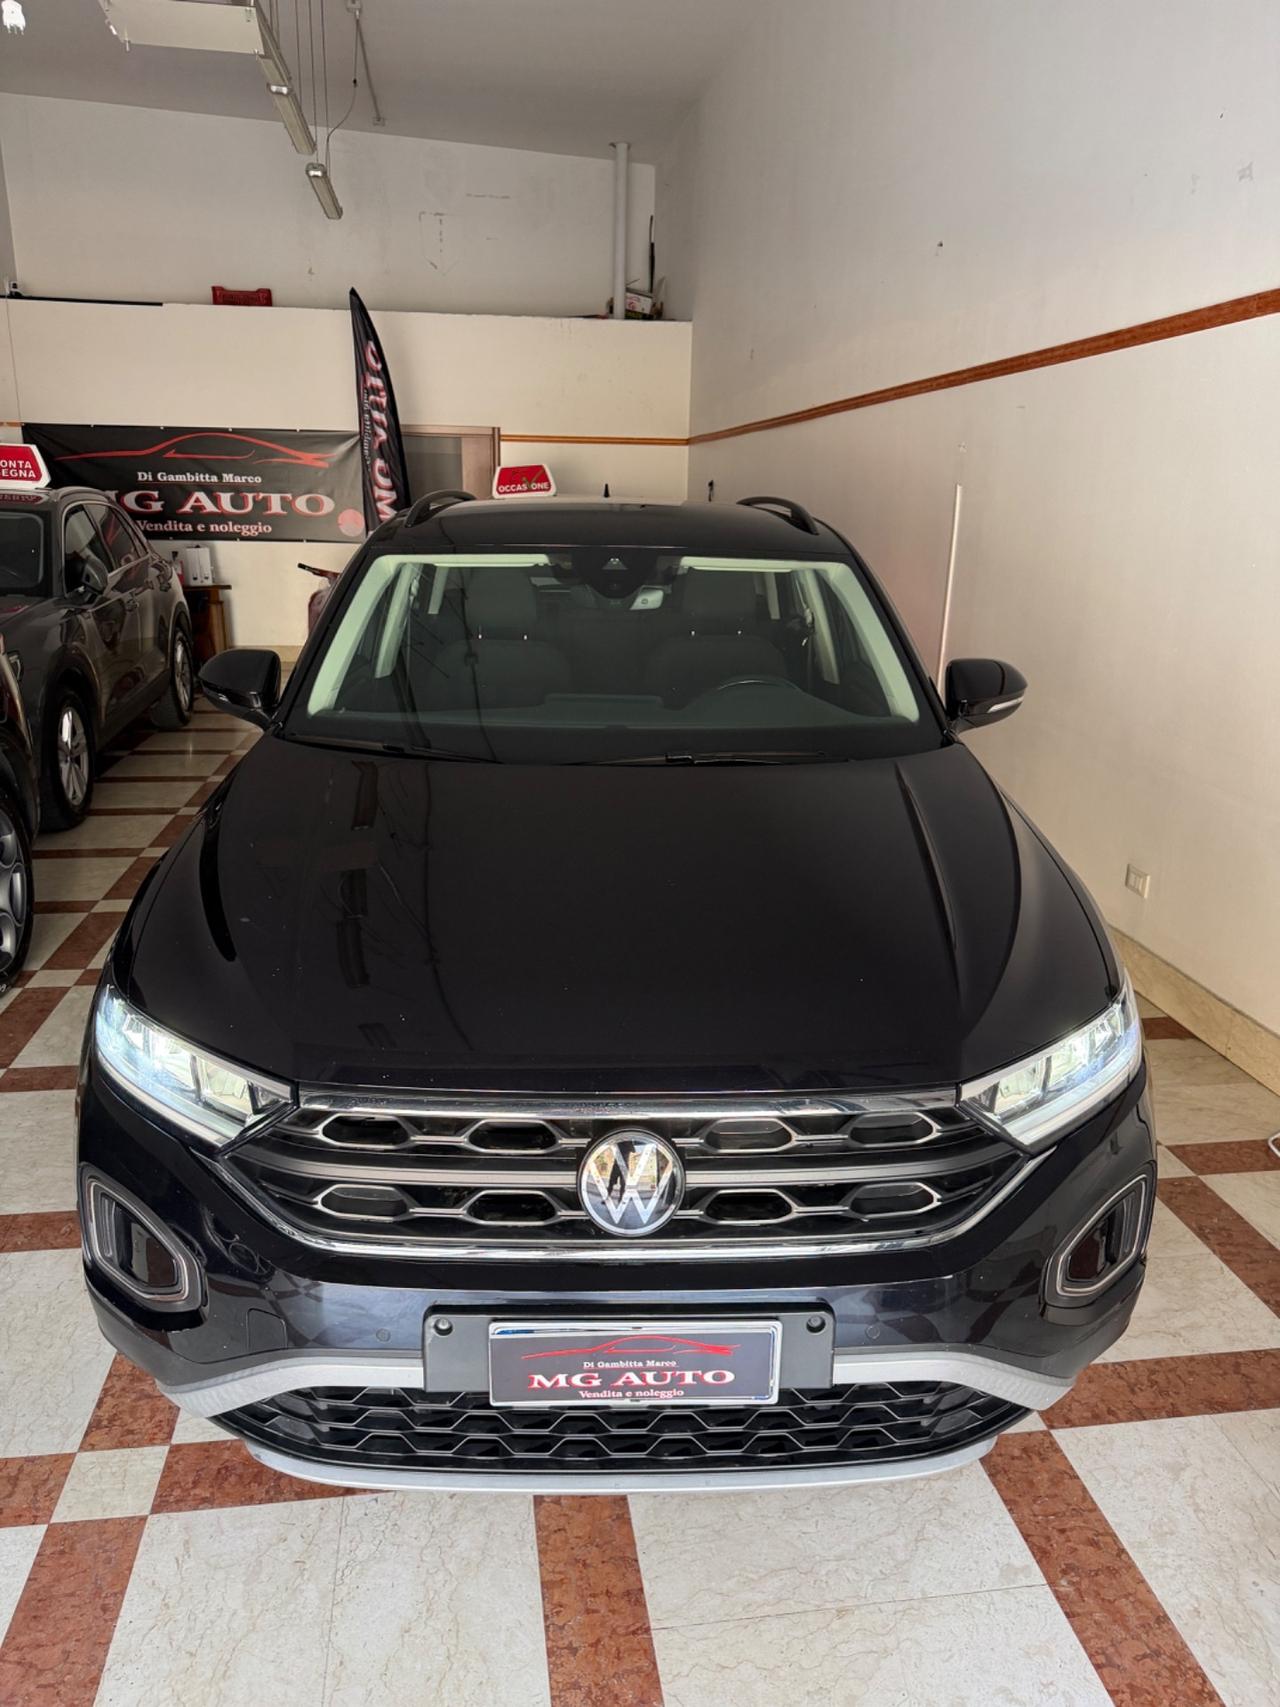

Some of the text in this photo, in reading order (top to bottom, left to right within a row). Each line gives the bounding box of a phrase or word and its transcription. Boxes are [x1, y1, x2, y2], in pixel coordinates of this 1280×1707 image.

[0, 468, 37, 478] EGNA
[137, 471, 262, 484] Di Gambitta Marco
[498, 481, 550, 493] OCCASONE
[176, 491, 335, 516] AUTO
[136, 520, 272, 536] Vendita e noleggio
[583, 1359, 677, 1369] Di Gambitta Marco
[527, 1370, 735, 1389] MG AUTO
[578, 1390, 622, 1399] Vendita
[635, 1388, 684, 1399] noleggio
